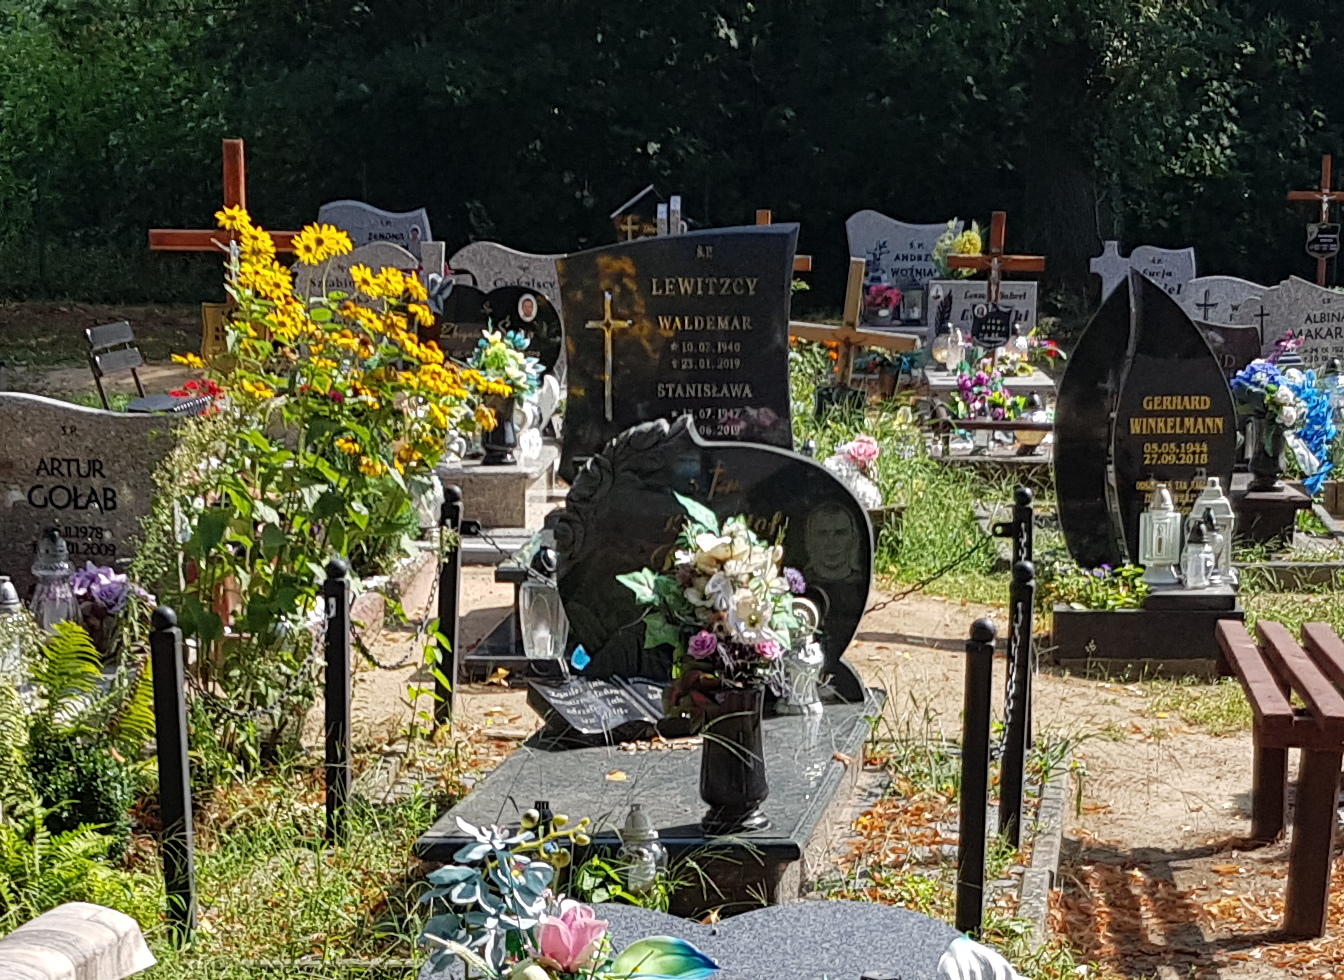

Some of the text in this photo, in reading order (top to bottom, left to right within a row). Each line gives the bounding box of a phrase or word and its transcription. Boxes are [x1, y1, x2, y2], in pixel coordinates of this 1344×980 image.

[894, 253, 932, 262] ANDRZ
[890, 264, 939, 278] WOŹNIA
[651, 277, 759, 296] LEWITZCY
[657, 315, 754, 331] WALDEMAR
[657, 383, 753, 398] STANISŁAWA
[1142, 396, 1211, 411] GERHARD
[1129, 417, 1225, 434] WINKELMANN
[1143, 442, 1208, 453] 05.05.1944
[1143, 453, 1208, 465] 27.09.2018
[36, 457, 106, 479] ARTUR
